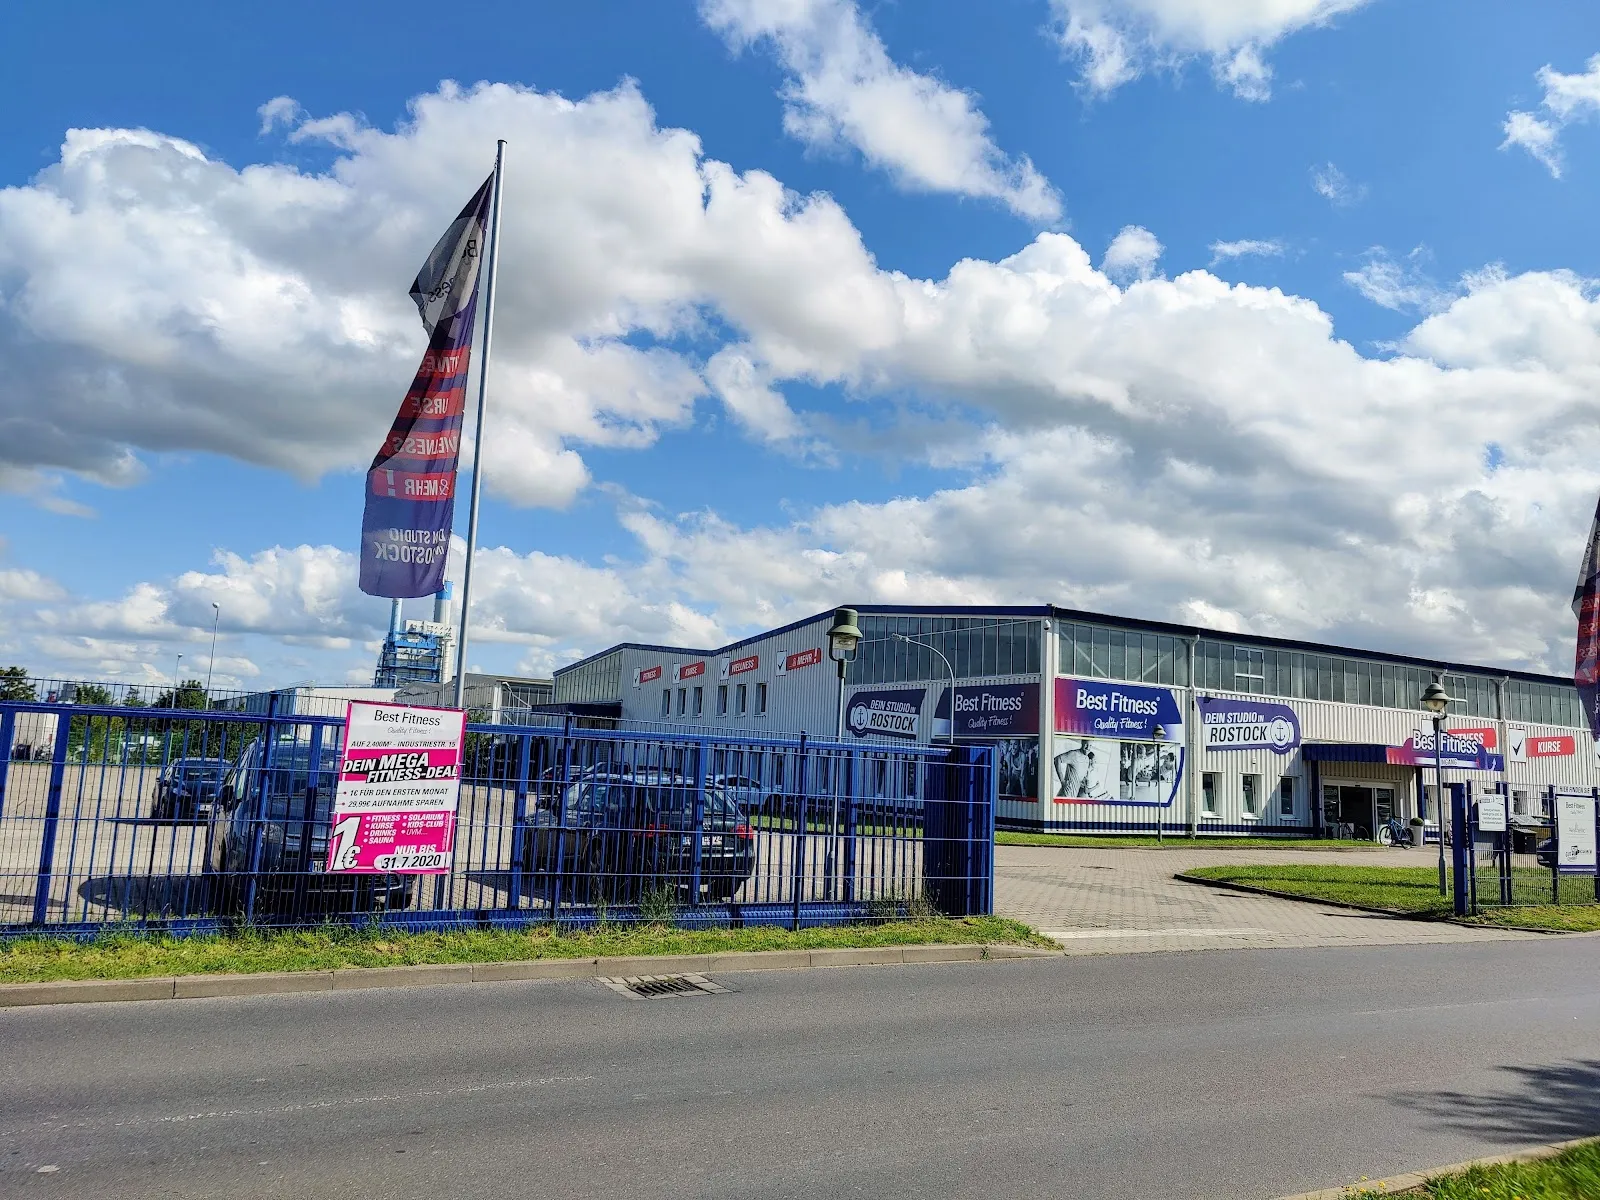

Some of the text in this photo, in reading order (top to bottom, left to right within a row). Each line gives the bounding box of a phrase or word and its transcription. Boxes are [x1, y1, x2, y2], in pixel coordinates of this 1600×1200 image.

[731, 660, 755, 672] WELLNESS
[870, 699, 886, 710] DEIN
[886, 701, 910, 713] STUDIO
[955, 693, 1022, 712] Best Fitness
[1076, 688, 1158, 715] Best Fitness
[374, 709, 440, 726] Best Fitness
[870, 712, 916, 732] ROSTOCK
[968, 715, 988, 730] Quality
[1094, 716, 1118, 732] Quality
[1205, 712, 1225, 724] DEIN
[1226, 712, 1257, 723] STUDIO
[1210, 726, 1268, 742] ROSTOCK
[1440, 732, 1478, 754] Fitness
[1538, 741, 1561, 753] KURSE
[342, 752, 428, 772] DEIN MEGA
[367, 765, 458, 783] FITNESS-DEAL
[360, 788, 373, 796] FÜR
[394, 844, 436, 854] NUR BIS
[381, 855, 441, 869] 31.7.2020
